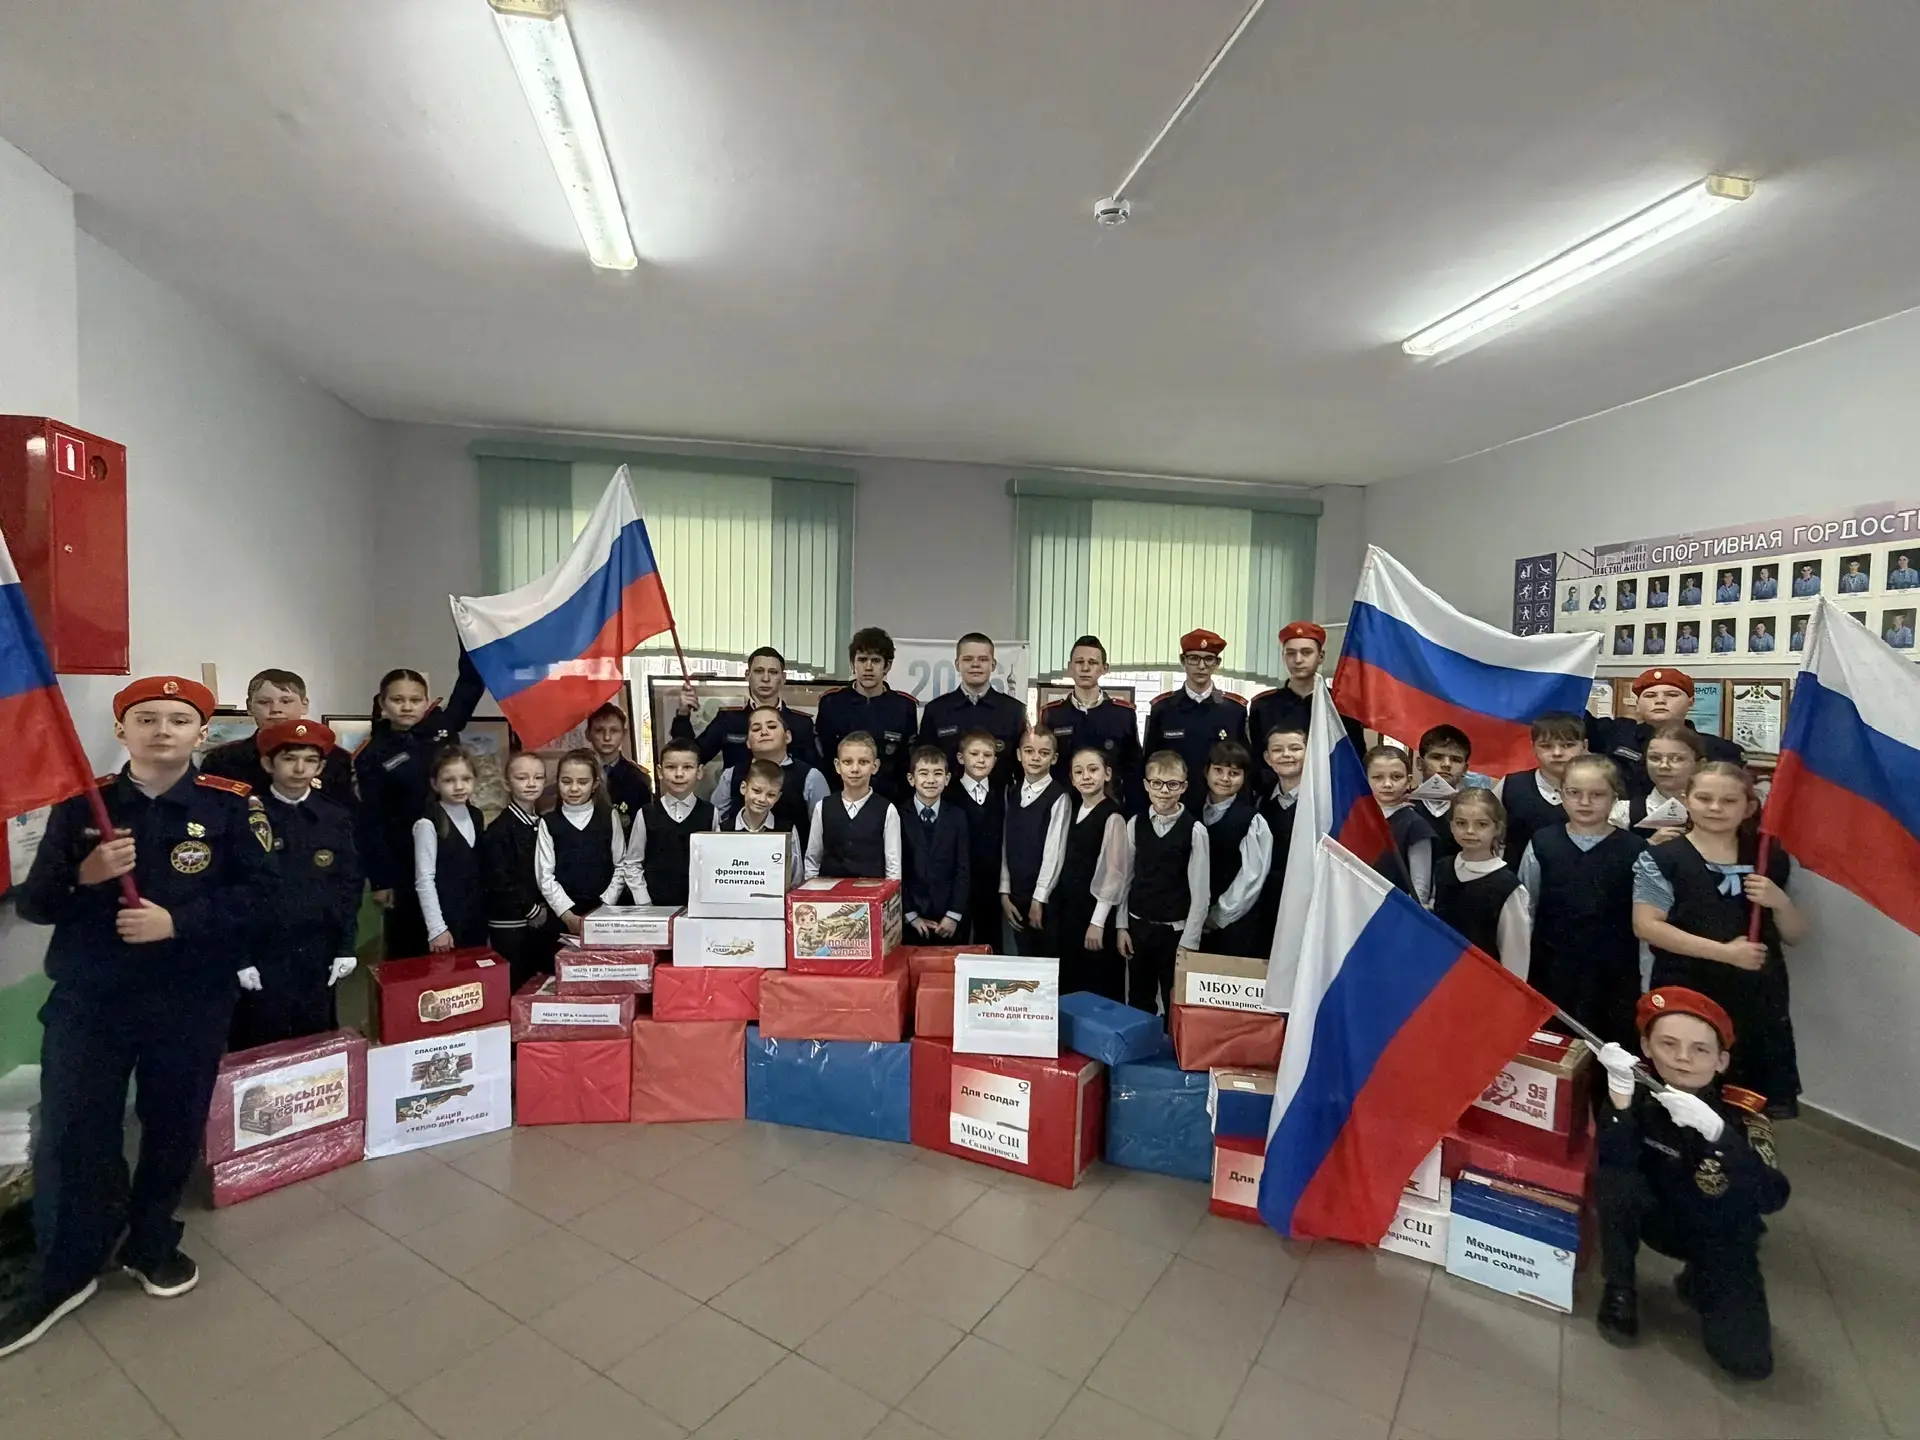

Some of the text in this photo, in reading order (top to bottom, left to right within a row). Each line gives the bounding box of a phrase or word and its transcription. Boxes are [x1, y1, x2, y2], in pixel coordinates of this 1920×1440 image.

[1652, 530, 1783, 564] СПОРТИВНАЯ
[731, 859, 750, 867] Для
[715, 868, 765, 877] фронтовых
[714, 878, 765, 886] госпиталей
[1199, 980, 1241, 995] МБОУ
[440, 990, 480, 1004] ПОСЫЛКА
[440, 997, 480, 1010] СОЛДАТУ
[414, 1045, 448, 1055] СПАСИБО
[274, 1080, 343, 1107] ПОСЫЛКА
[961, 1085, 1020, 1107] Для солдат
[1527, 1083, 1539, 1099] 9
[275, 1092, 342, 1119] СОЛДАТУ
[435, 1110, 462, 1121] АКЦИЯ
[438, 1119, 455, 1128] ДЛЯ
[961, 1122, 1020, 1148] МБОУ СШ
[1229, 1170, 1255, 1184] Для
[1403, 1218, 1433, 1235] СШ
[1466, 1235, 1535, 1266] Медицина
[1464, 1250, 1540, 1280] для солдат
